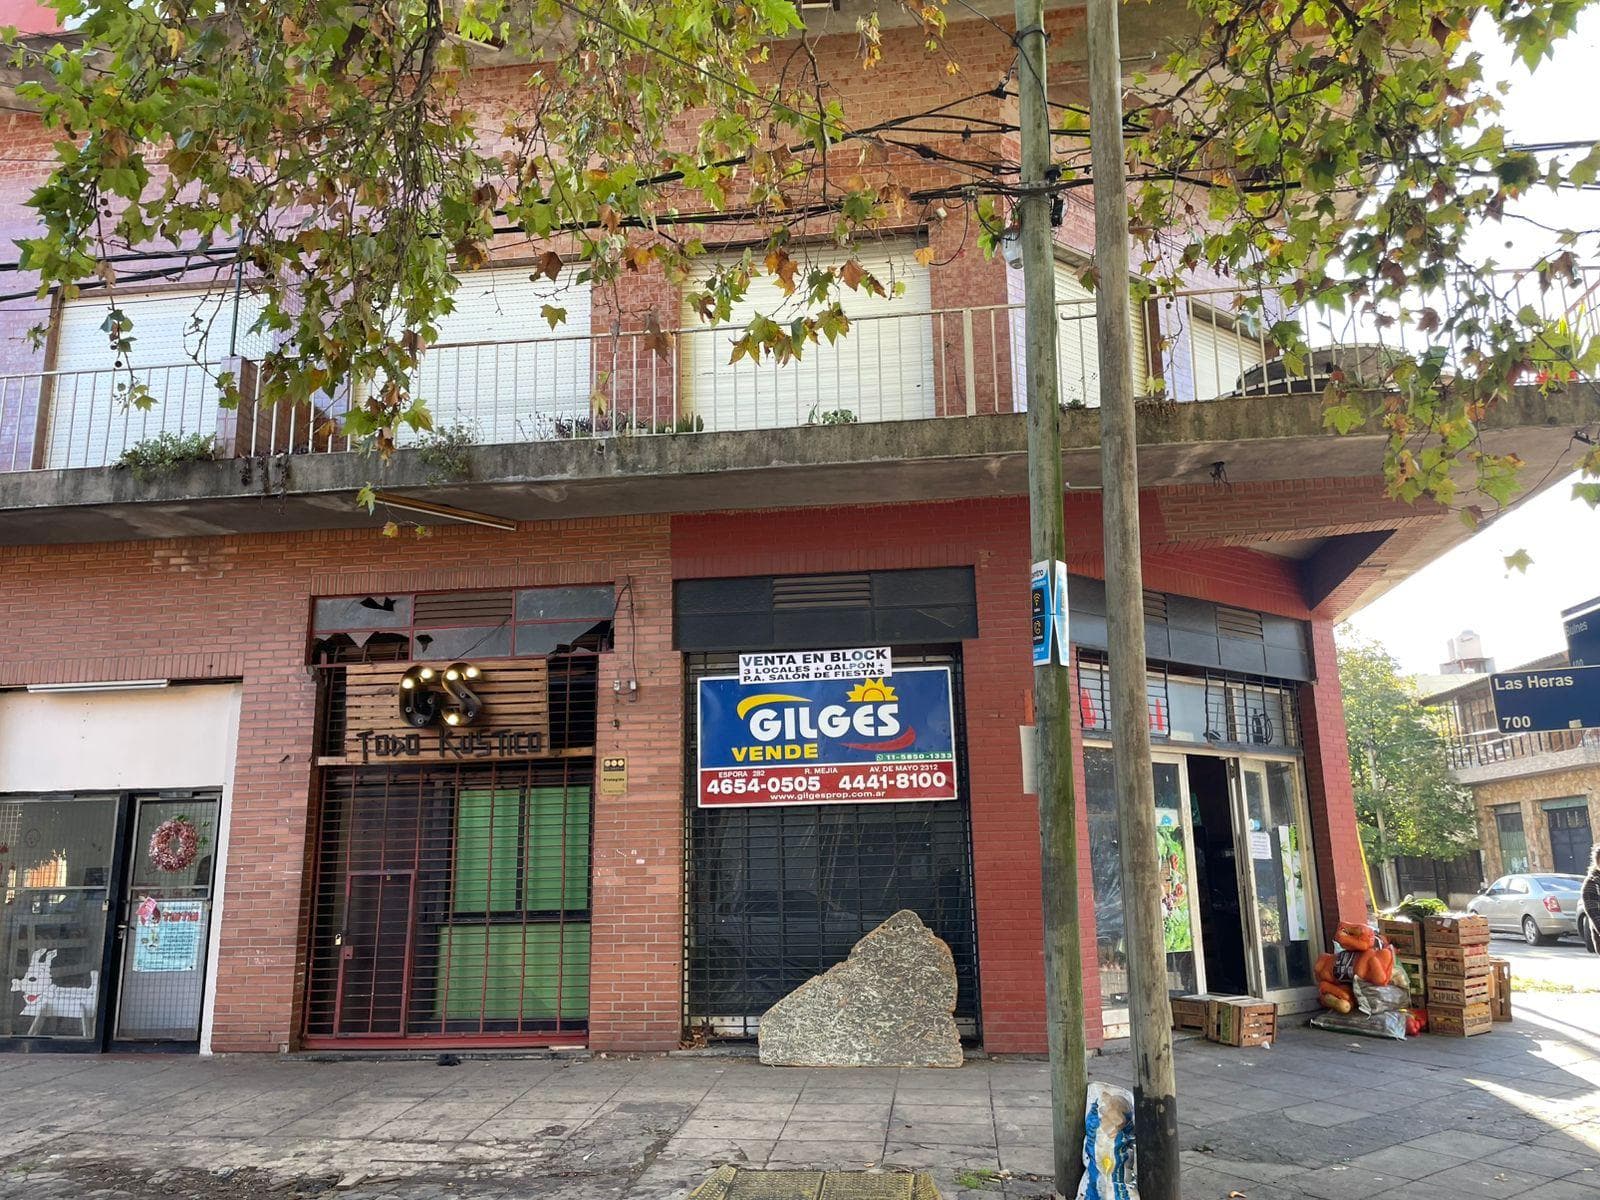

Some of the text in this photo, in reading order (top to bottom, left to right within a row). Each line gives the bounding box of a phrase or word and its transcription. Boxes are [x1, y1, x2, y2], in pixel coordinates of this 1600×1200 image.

[741, 649, 888, 667] VENTA EN BLOCK
[755, 665, 811, 675] LOCALES
[824, 661, 875, 671] GALPÓN
[814, 671, 831, 679] DE
[834, 668, 885, 678] FIESTAS
[1494, 675, 1574, 691] Las Heras
[749, 703, 901, 742] GILGES
[1502, 715, 1531, 729] 700
[731, 743, 819, 762] VENDE
[718, 770, 748, 778] ESPORA
[804, 767, 812, 775] R.
[869, 765, 880, 773] AV.
[707, 776, 821, 794] 4654-0505
[838, 772, 947, 790] 4441-8100
[770, 791, 886, 800] www.gilgesprop.com.ar
